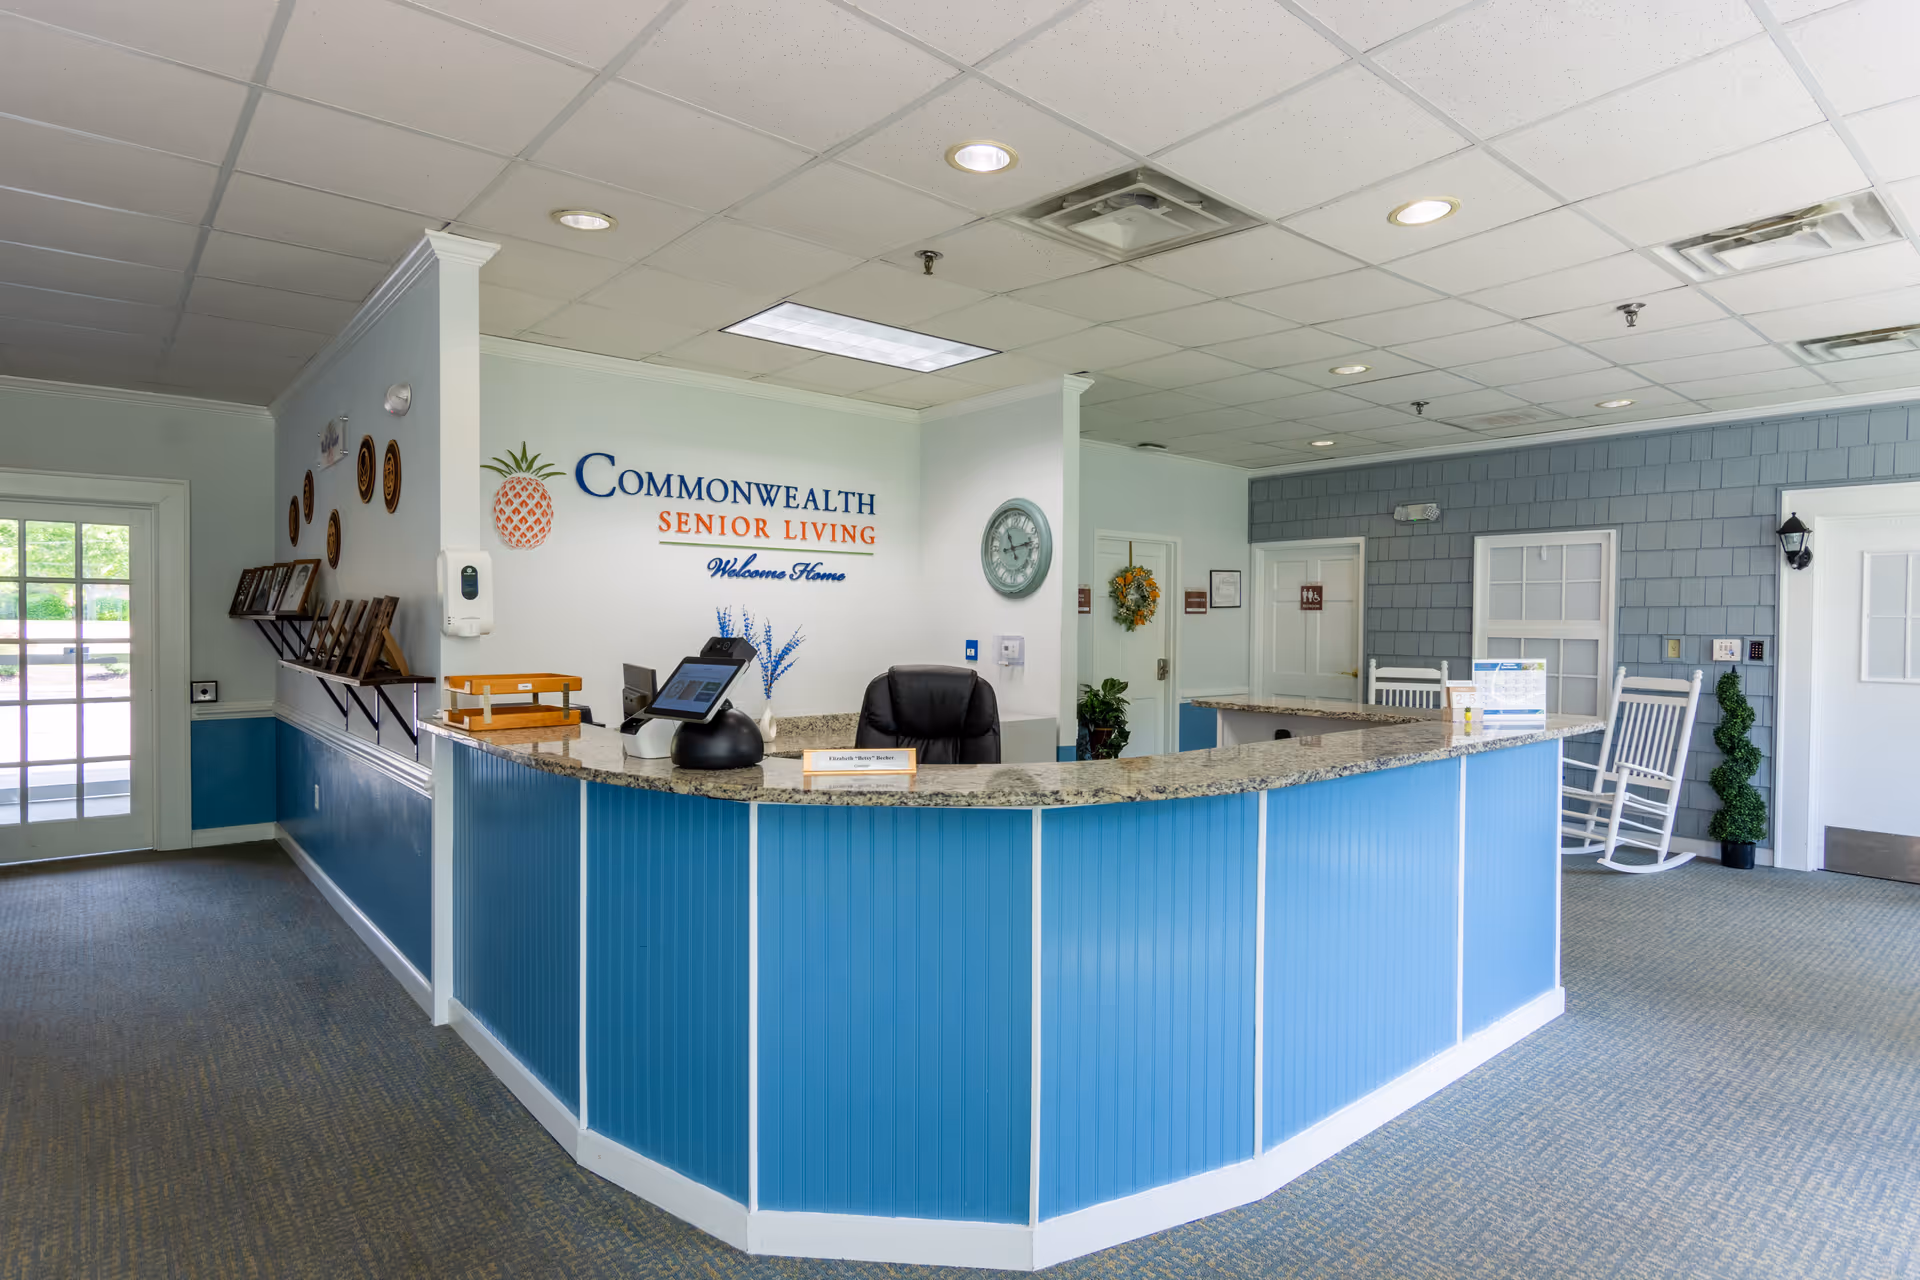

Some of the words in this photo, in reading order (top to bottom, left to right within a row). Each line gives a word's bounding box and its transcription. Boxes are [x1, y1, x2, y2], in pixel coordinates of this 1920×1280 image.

[576, 453, 876, 515] COMMONWEALTH
[659, 511, 770, 538] SENIOR
[784, 520, 875, 544] LIVING
[708, 553, 786, 580] Welcome
[789, 562, 845, 581] Home
